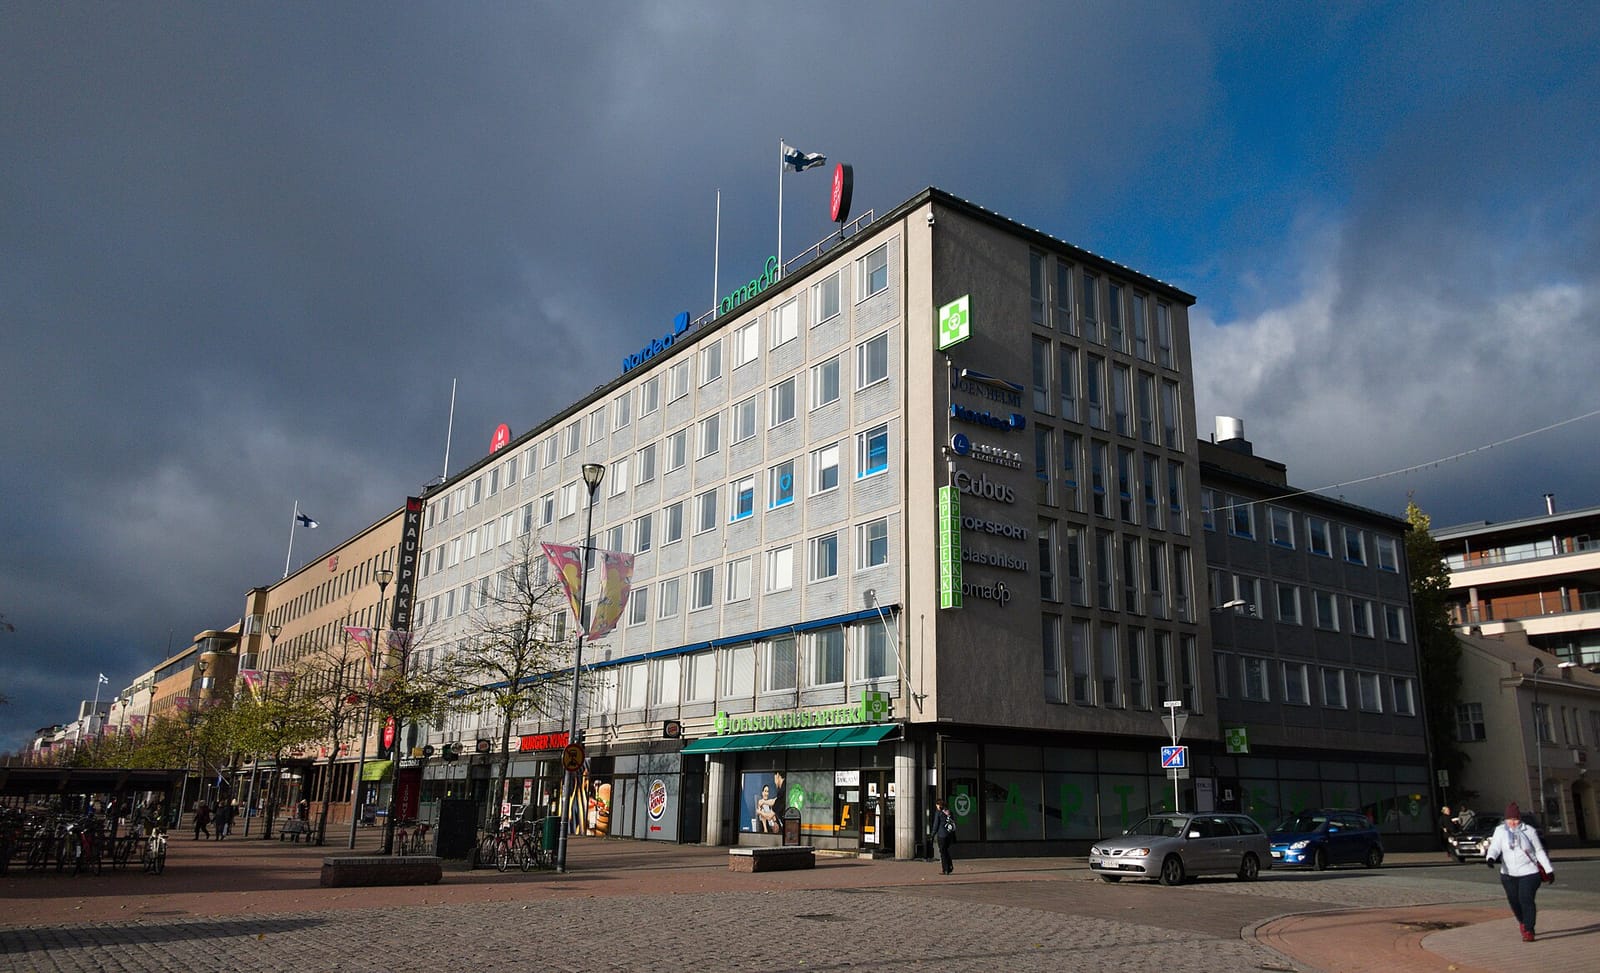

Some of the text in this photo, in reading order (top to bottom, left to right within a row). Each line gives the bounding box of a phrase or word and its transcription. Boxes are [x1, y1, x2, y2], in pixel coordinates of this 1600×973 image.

[622, 333, 675, 374] Nordea
[954, 470, 1015, 503] Cubus
[941, 491, 949, 606] APTEEKKI
[951, 492, 960, 606] APTEEKKI
[962, 546, 1029, 571] clas ohlson
[728, 713, 781, 735] JOENSUUN
[522, 735, 549, 751] BURGER
